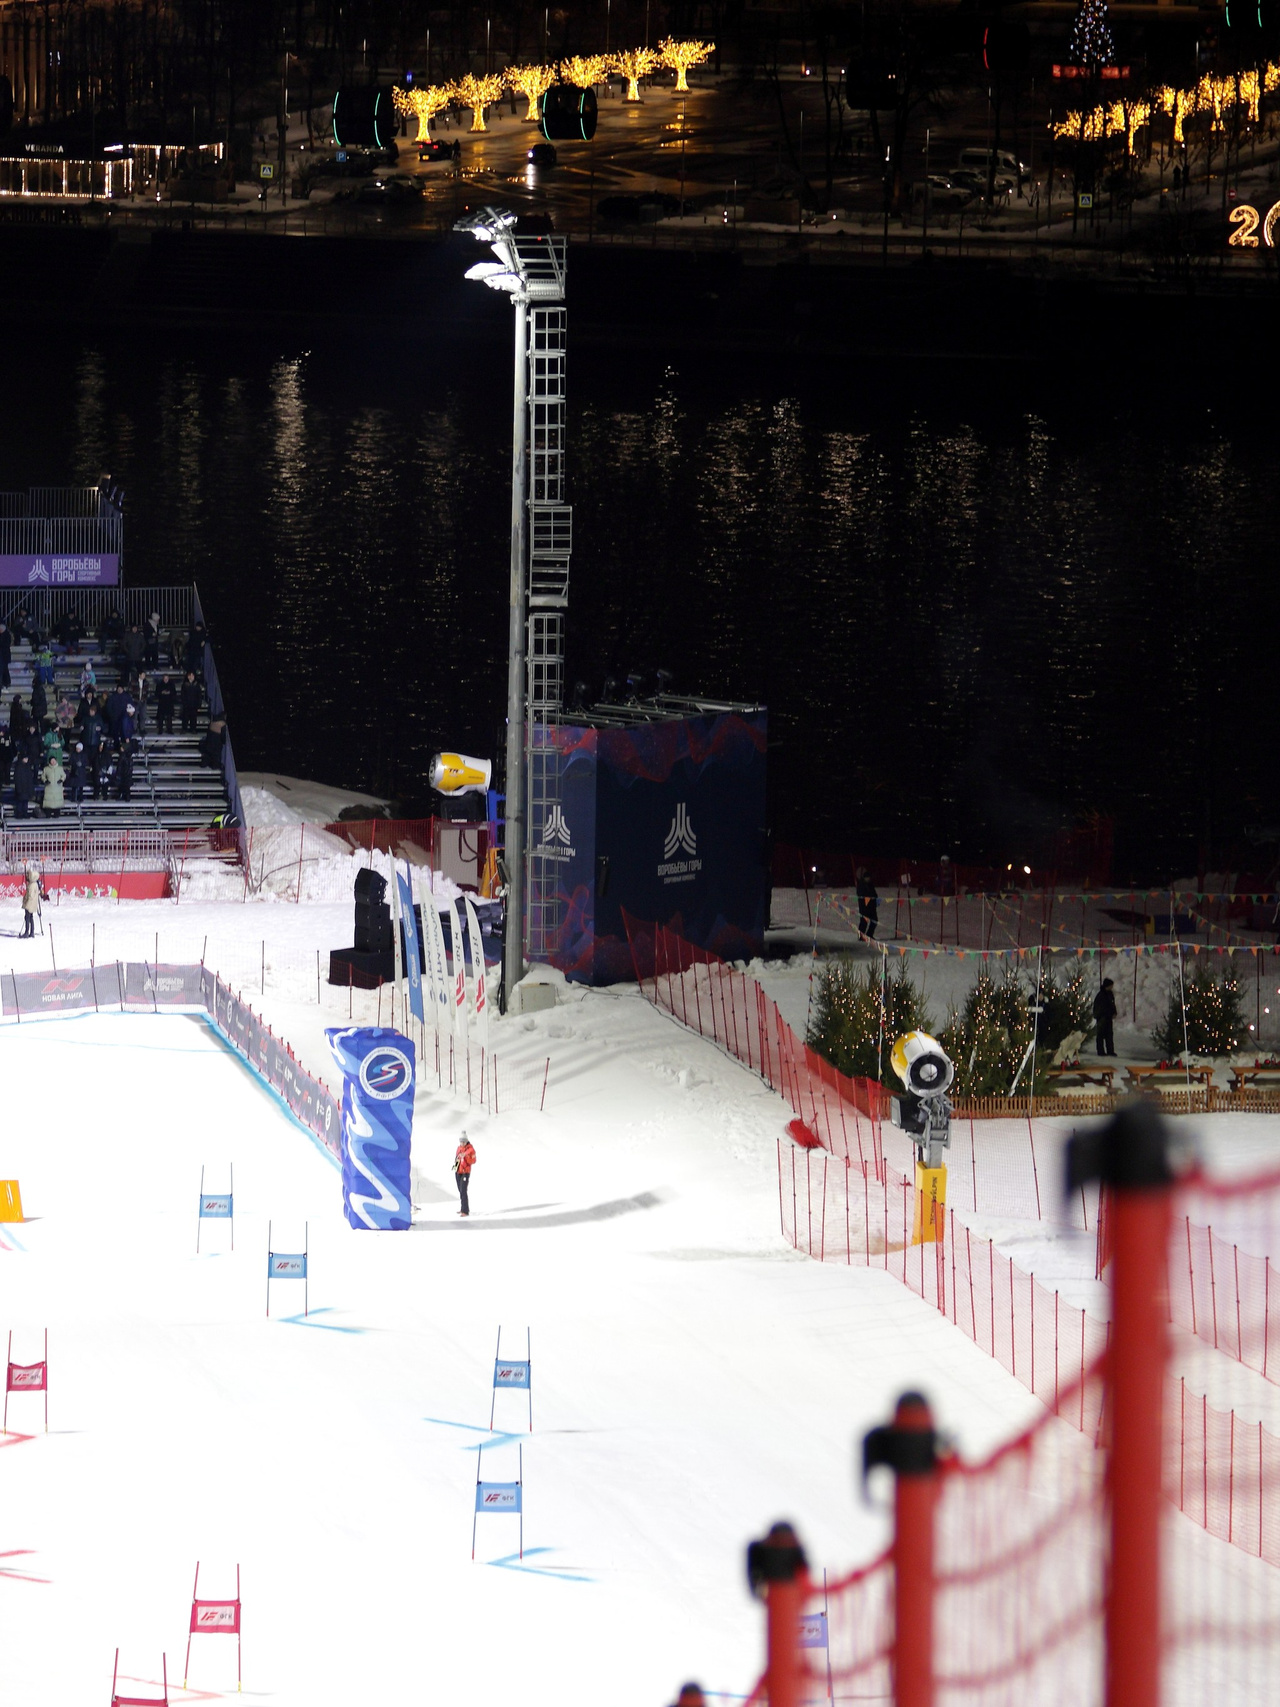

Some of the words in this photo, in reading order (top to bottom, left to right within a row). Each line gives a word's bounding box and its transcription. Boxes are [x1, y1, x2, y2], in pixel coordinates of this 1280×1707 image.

[25, 144, 64, 153] VERANDA
[51, 557, 101, 570] ВОРОБЬЁВЫ
[51, 570, 76, 582] ГОРЫ
[42, 994, 66, 1003] НОВАЯ
[67, 991, 84, 1000] ЛИГА
